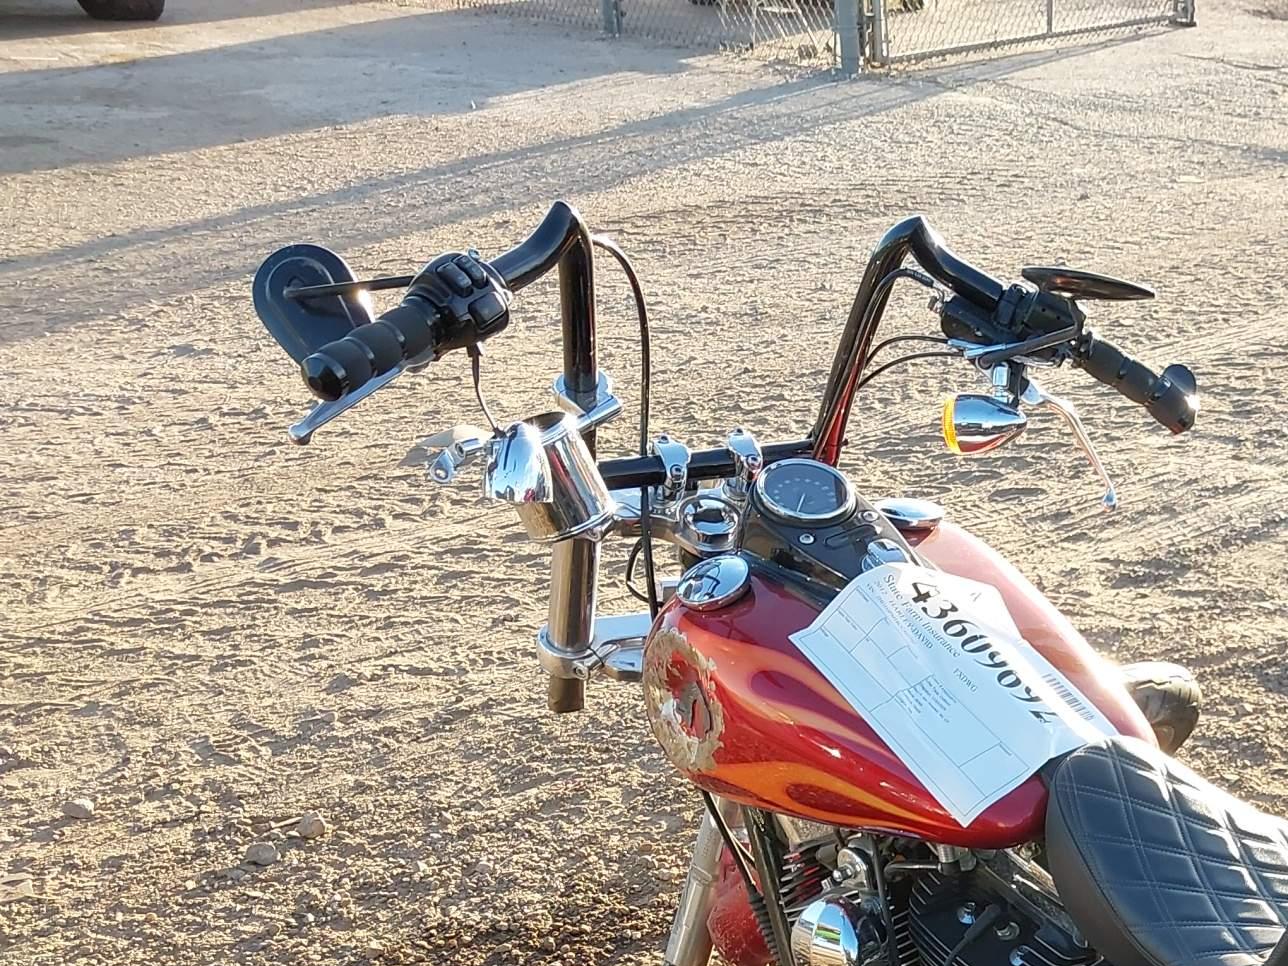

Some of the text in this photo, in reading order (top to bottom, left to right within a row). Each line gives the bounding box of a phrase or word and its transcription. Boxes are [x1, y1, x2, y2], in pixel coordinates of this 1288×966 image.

[883, 574, 961, 658] State Farm Insurance
[911, 582, 1059, 724] 43609692
